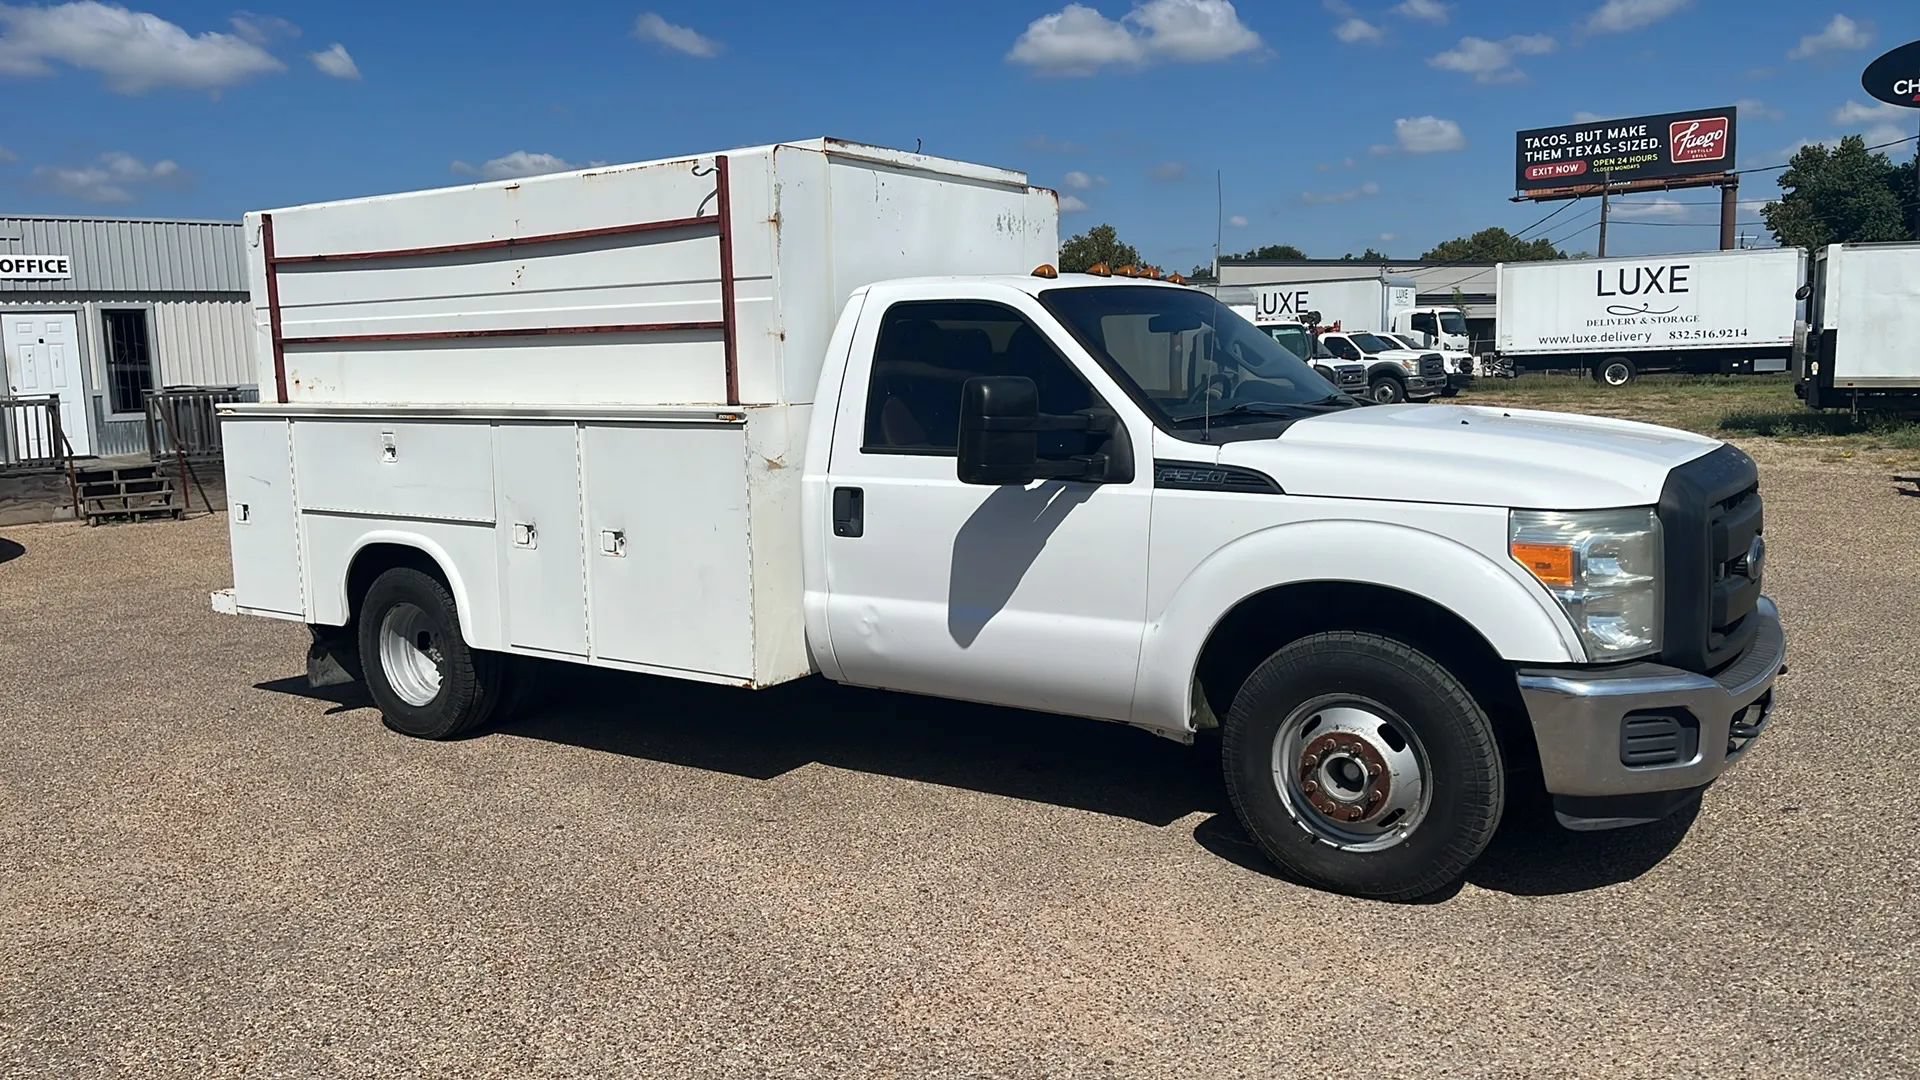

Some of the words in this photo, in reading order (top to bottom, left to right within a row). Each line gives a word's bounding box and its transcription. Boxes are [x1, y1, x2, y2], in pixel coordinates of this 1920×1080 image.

[1525, 133, 1571, 149] TACOS.
[1575, 130, 1602, 143] BUT
[1607, 125, 1647, 139] MAKE
[1525, 149, 1562, 162] THEM
[1566, 137, 1662, 158] TEXAS-SIZED.
[1593, 158, 1616, 167] OPEN
[1629, 153, 1658, 163] HOURS
[1614, 163, 1640, 171] MONDAYS
[1532, 166, 1553, 177] EXIT
[1555, 164, 1579, 174] NOW
[0, 259, 68, 273] OFFICE
[1597, 265, 1690, 296] LUXE
[1258, 291, 1309, 315] UXE
[1586, 317, 1638, 327] DELIVERY
[1640, 316, 1647, 325] &
[1650, 314, 1700, 325] STORAGE
[1538, 331, 1652, 347] www.luxe.delivery
[1669, 328, 1748, 340] 832.516.9214
